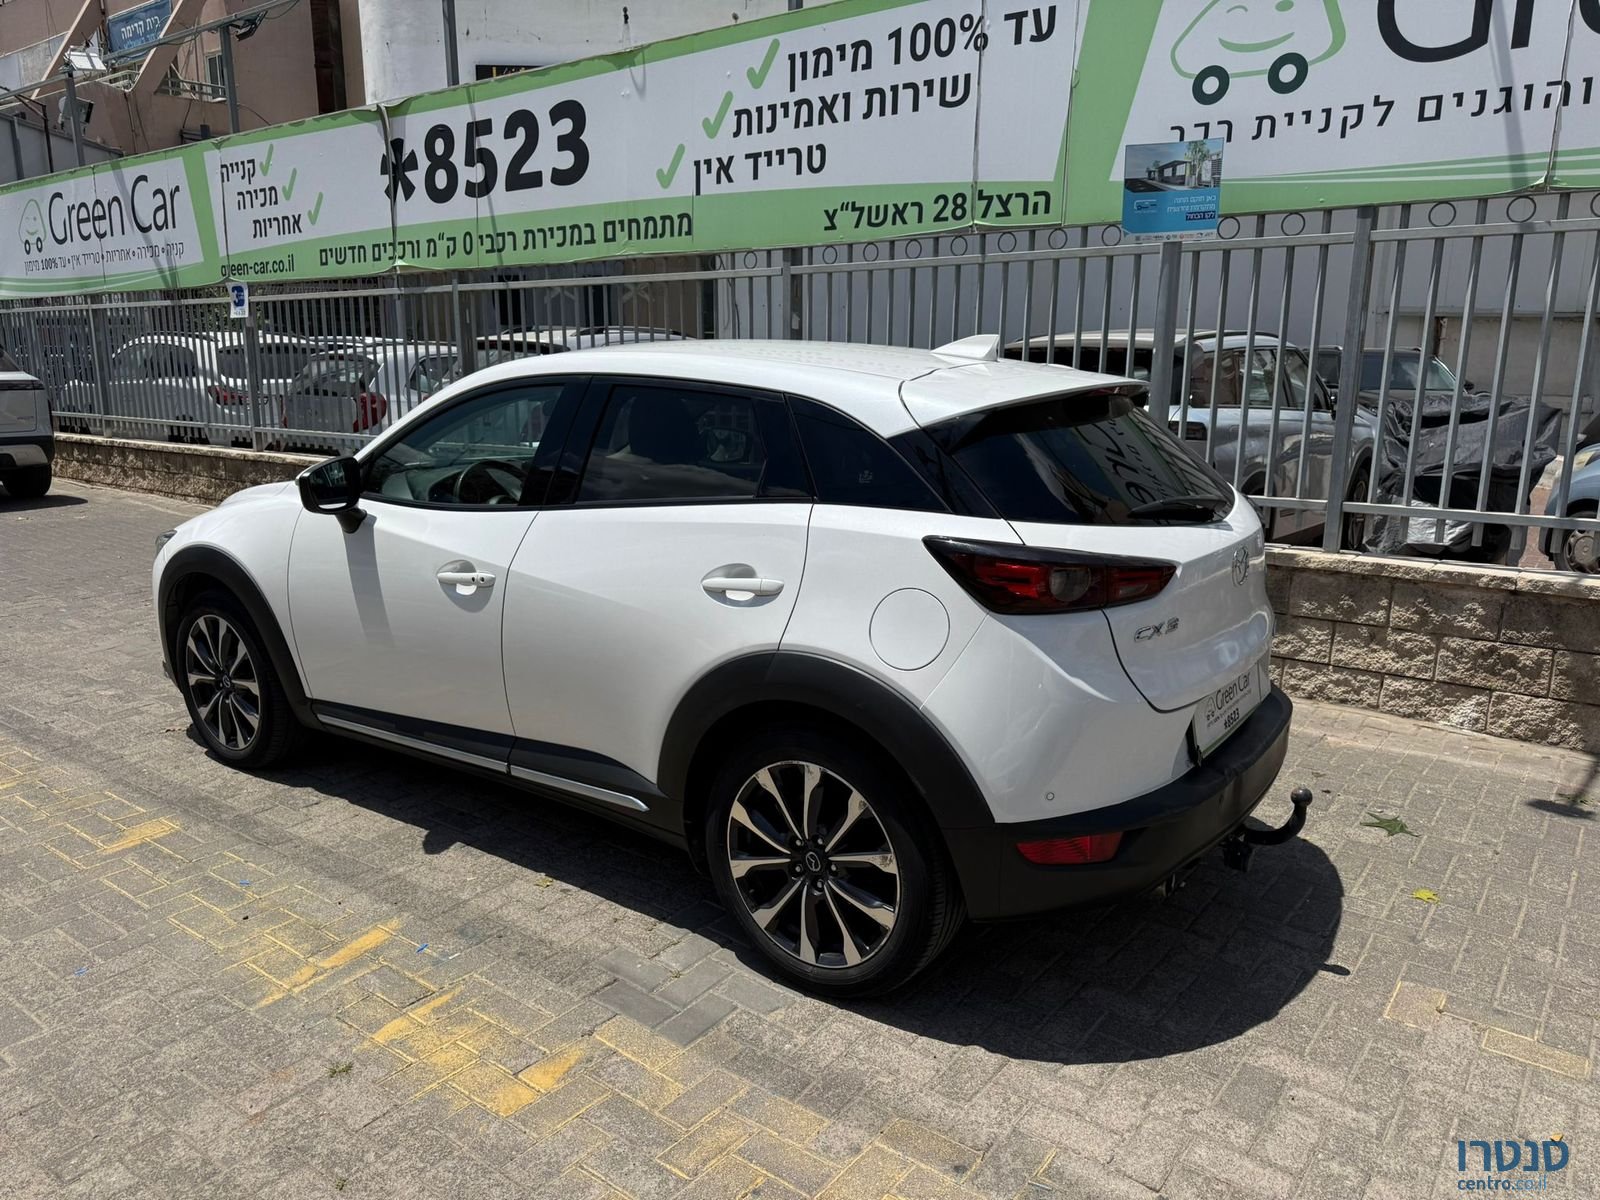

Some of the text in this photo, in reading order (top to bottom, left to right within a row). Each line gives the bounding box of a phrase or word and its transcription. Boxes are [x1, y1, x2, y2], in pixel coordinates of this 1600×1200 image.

[146, 16, 160, 31] בית
[788, 5, 1057, 92] עד 100% מימון
[732, 73, 971, 138] שירות ואמינות
[1416, 76, 1594, 123] והוגנים
[1252, 95, 1395, 140] לקניית
[220, 158, 256, 185] קנייה
[693, 143, 827, 196] טרייד אין
[48, 174, 181, 246] Green Car
[237, 185, 279, 210] מכירה
[933, 192, 968, 223] 28
[977, 189, 1051, 219] הרצל
[253, 213, 303, 239] אחריות
[523, 222, 596, 250] במכירת
[603, 212, 692, 243] מתמחים
[106, 248, 131, 263] אחריות
[137, 245, 160, 260] מכירה
[166, 242, 185, 259] קניה
[319, 244, 367, 266] חדשים
[371, 239, 420, 262] ורכבים
[478, 231, 517, 254] רכבי
[41, 258, 58, 270] 100%
[1216, 682, 1238, 710] Green
[1237, 671, 1251, 692] Car
